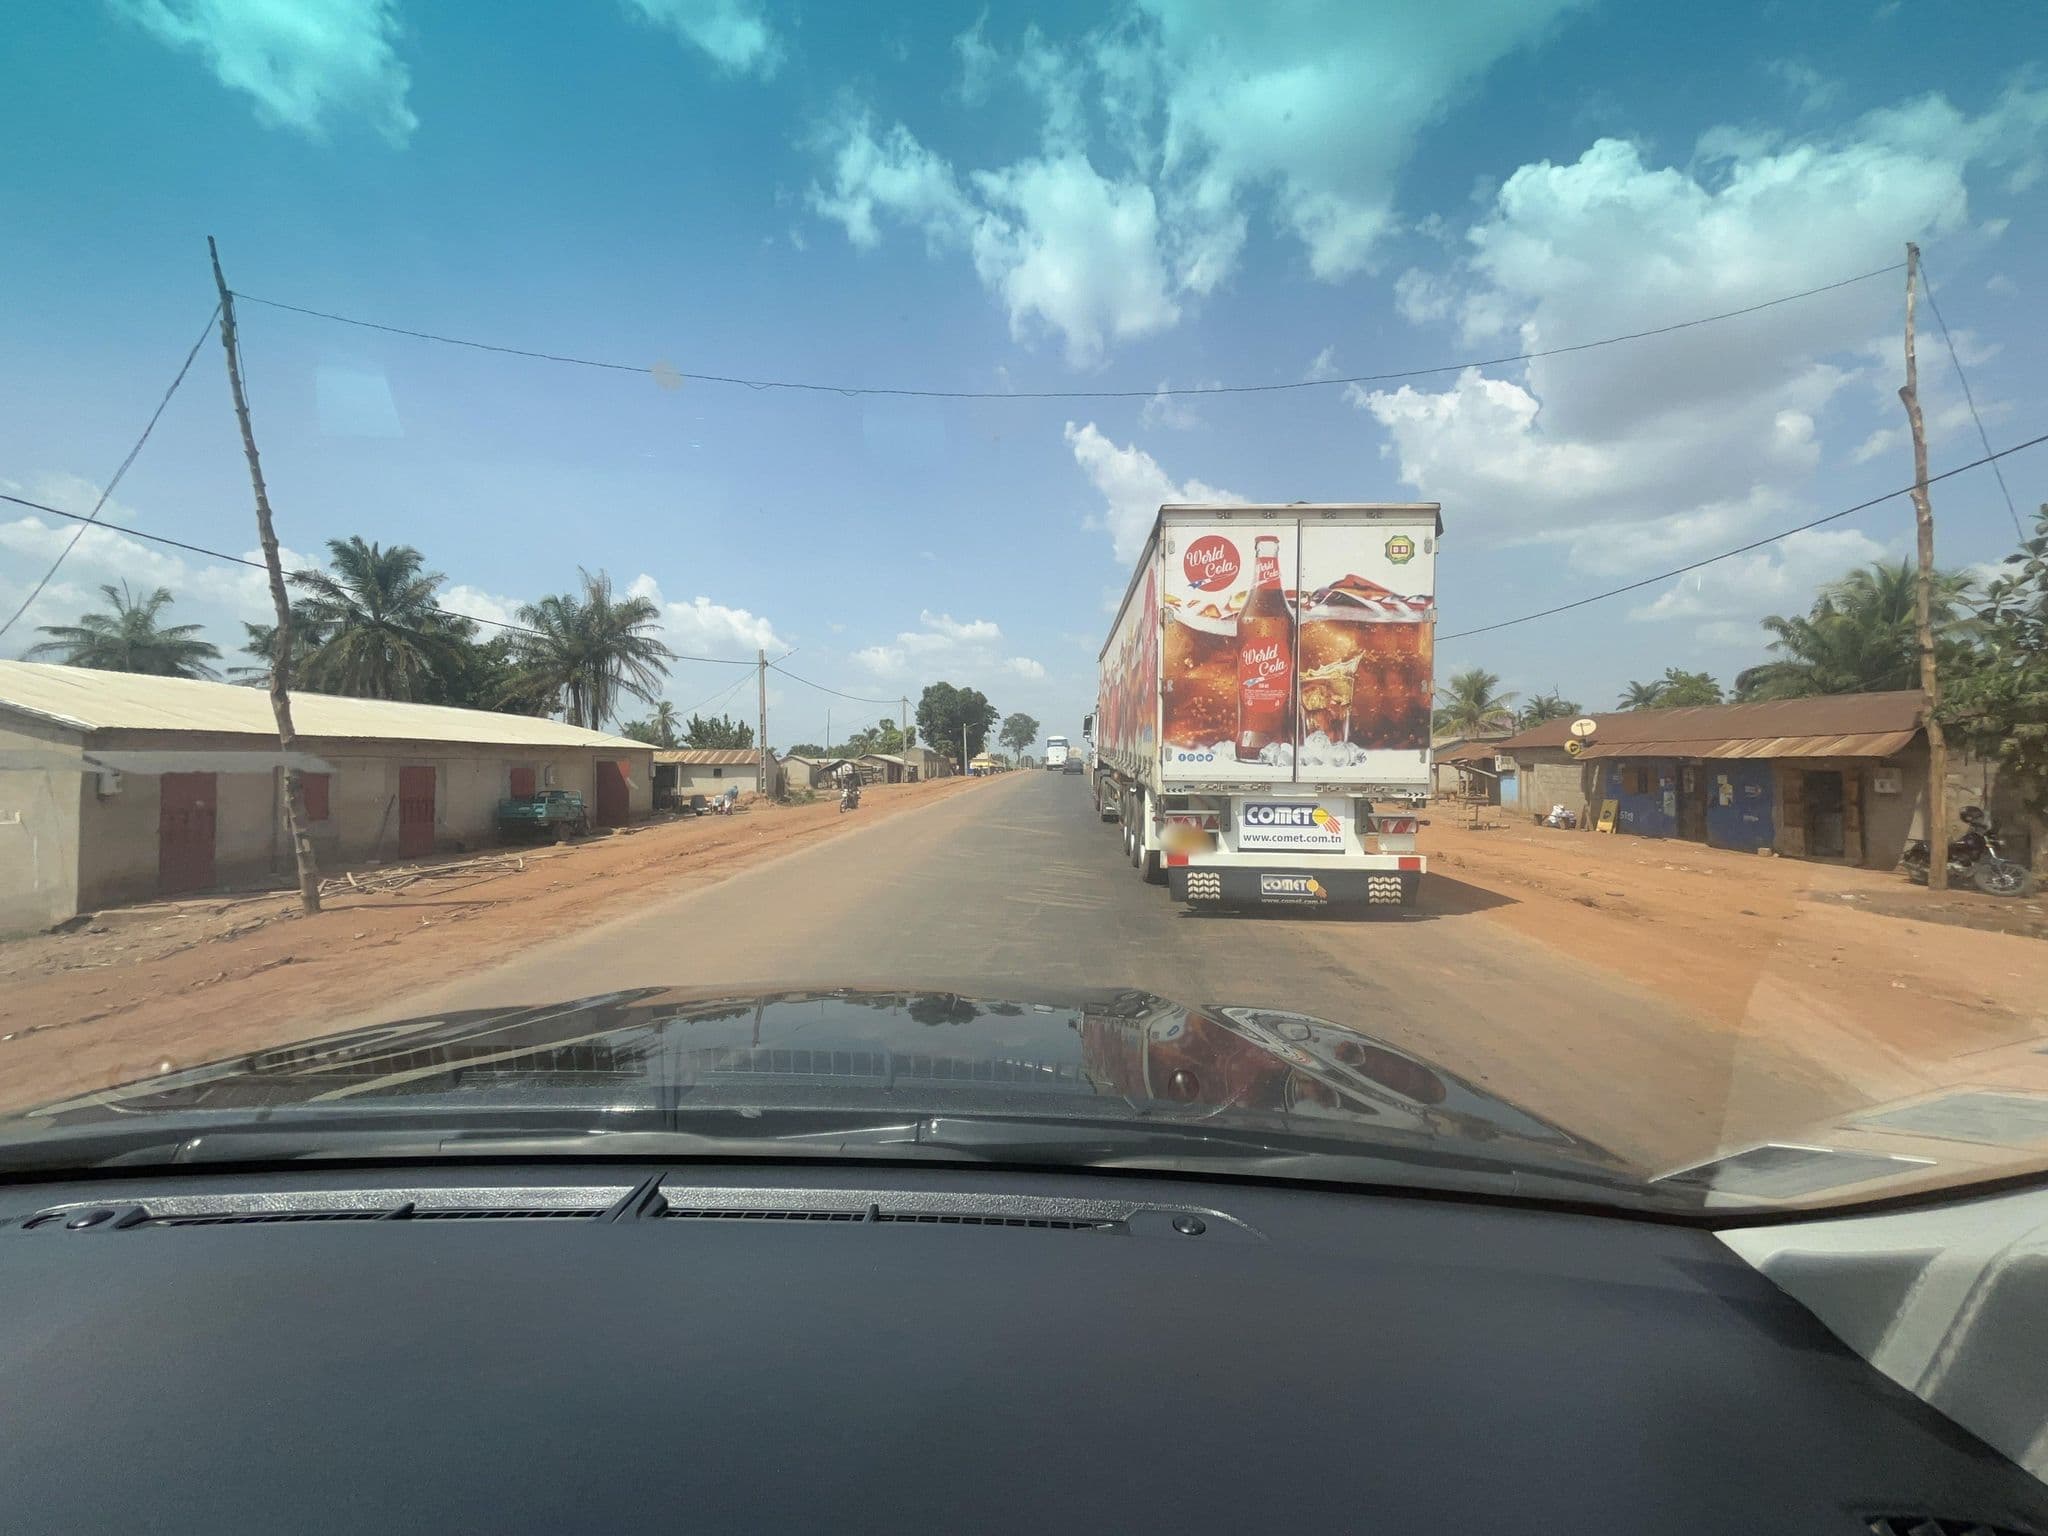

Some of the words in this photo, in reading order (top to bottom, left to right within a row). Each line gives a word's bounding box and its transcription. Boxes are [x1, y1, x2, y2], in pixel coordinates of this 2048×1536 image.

[1186, 545, 1224, 567] World
[1206, 560, 1238, 578] Cola
[1243, 644, 1278, 665] World
[1259, 659, 1287, 675] Cola
[1246, 806, 1313, 825] COMET
[1243, 834, 1342, 843] www.comet.com.tn
[1263, 879, 1306, 891] COMET
